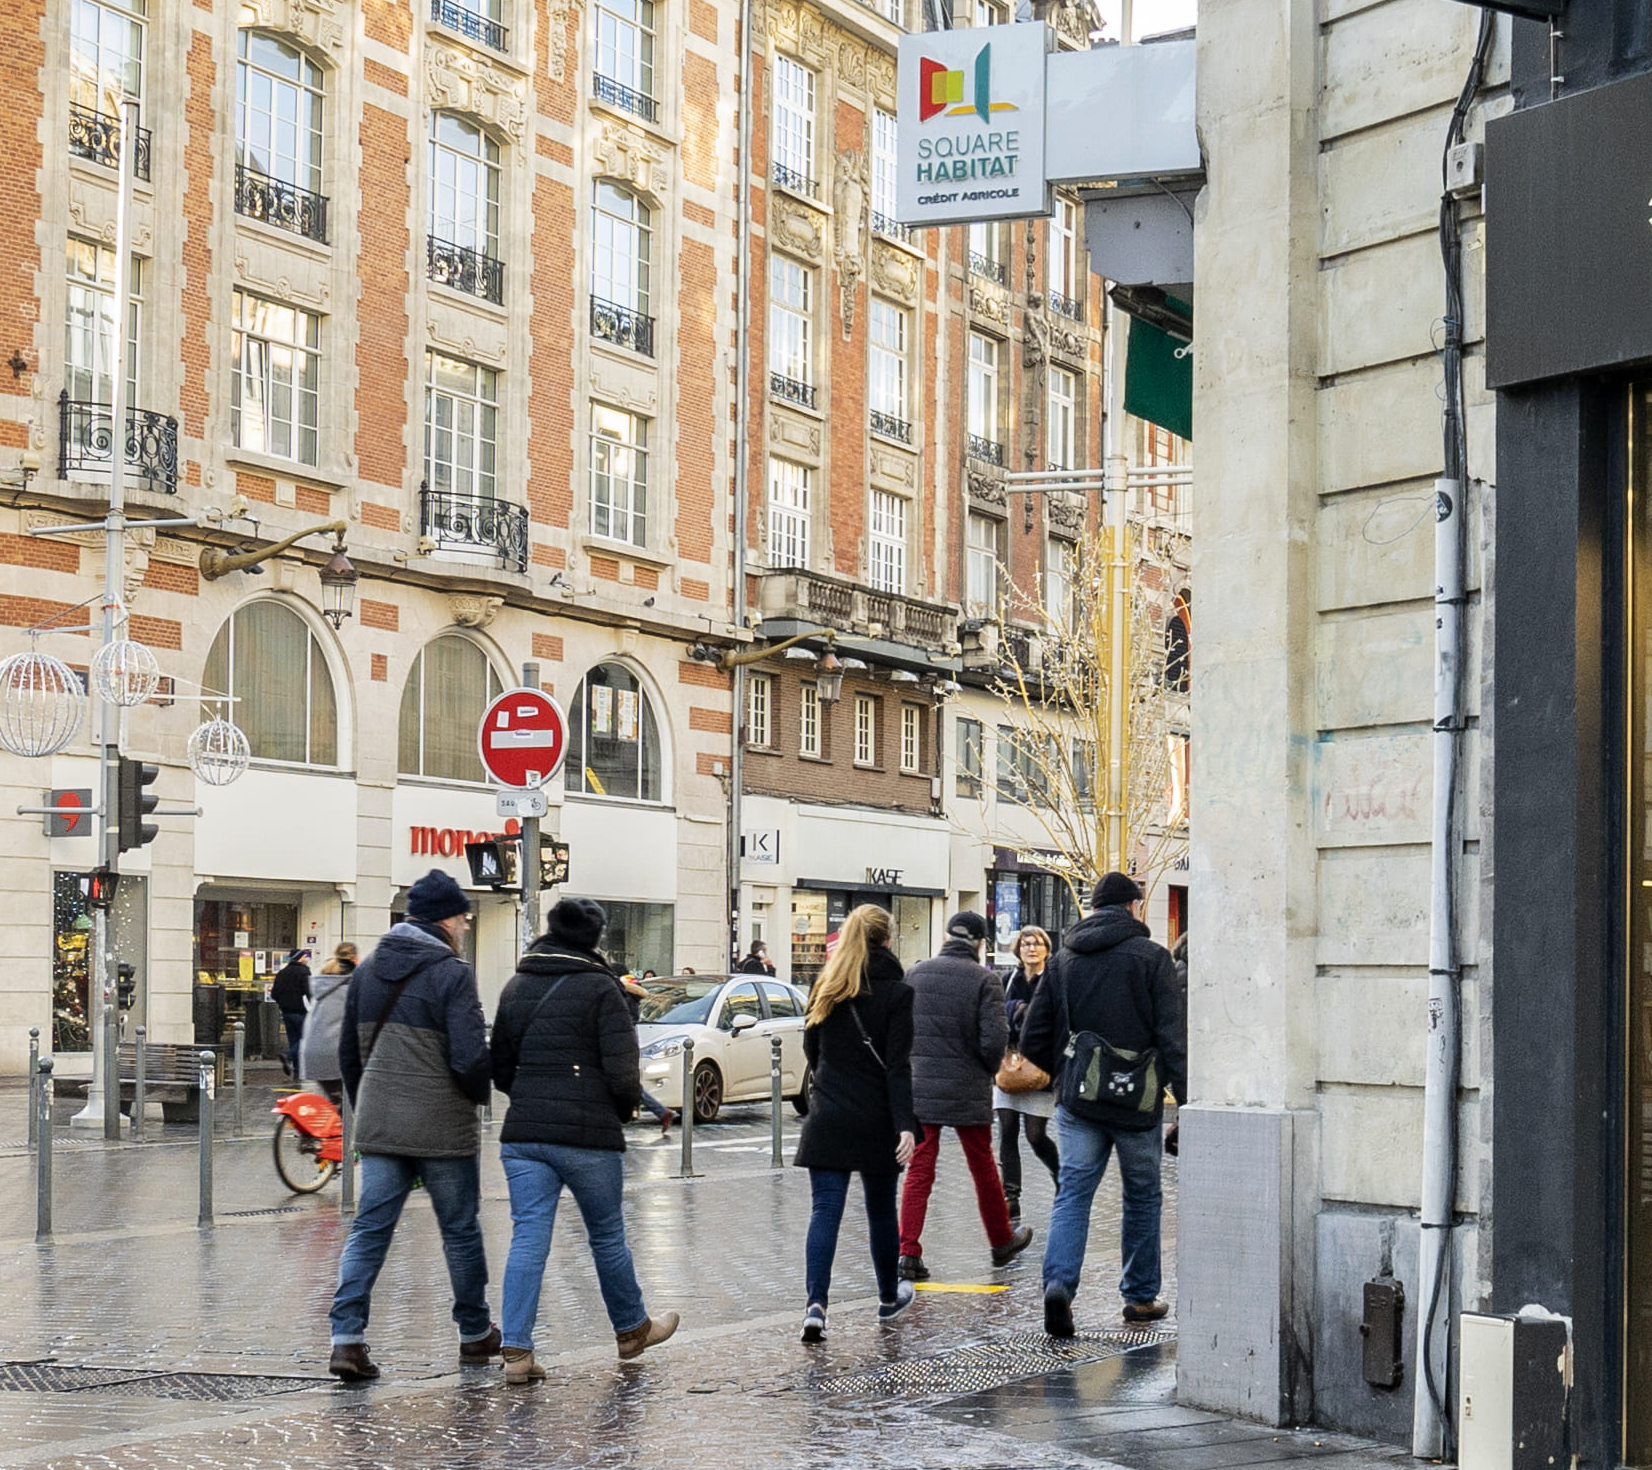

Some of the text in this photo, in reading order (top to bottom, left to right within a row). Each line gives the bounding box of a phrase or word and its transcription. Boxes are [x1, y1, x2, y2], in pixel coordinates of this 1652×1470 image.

[917, 131, 1020, 159] SQUARE
[916, 155, 1018, 183] HABITAT
[917, 187, 1020, 206] CRÉDIT AGRICOLE
